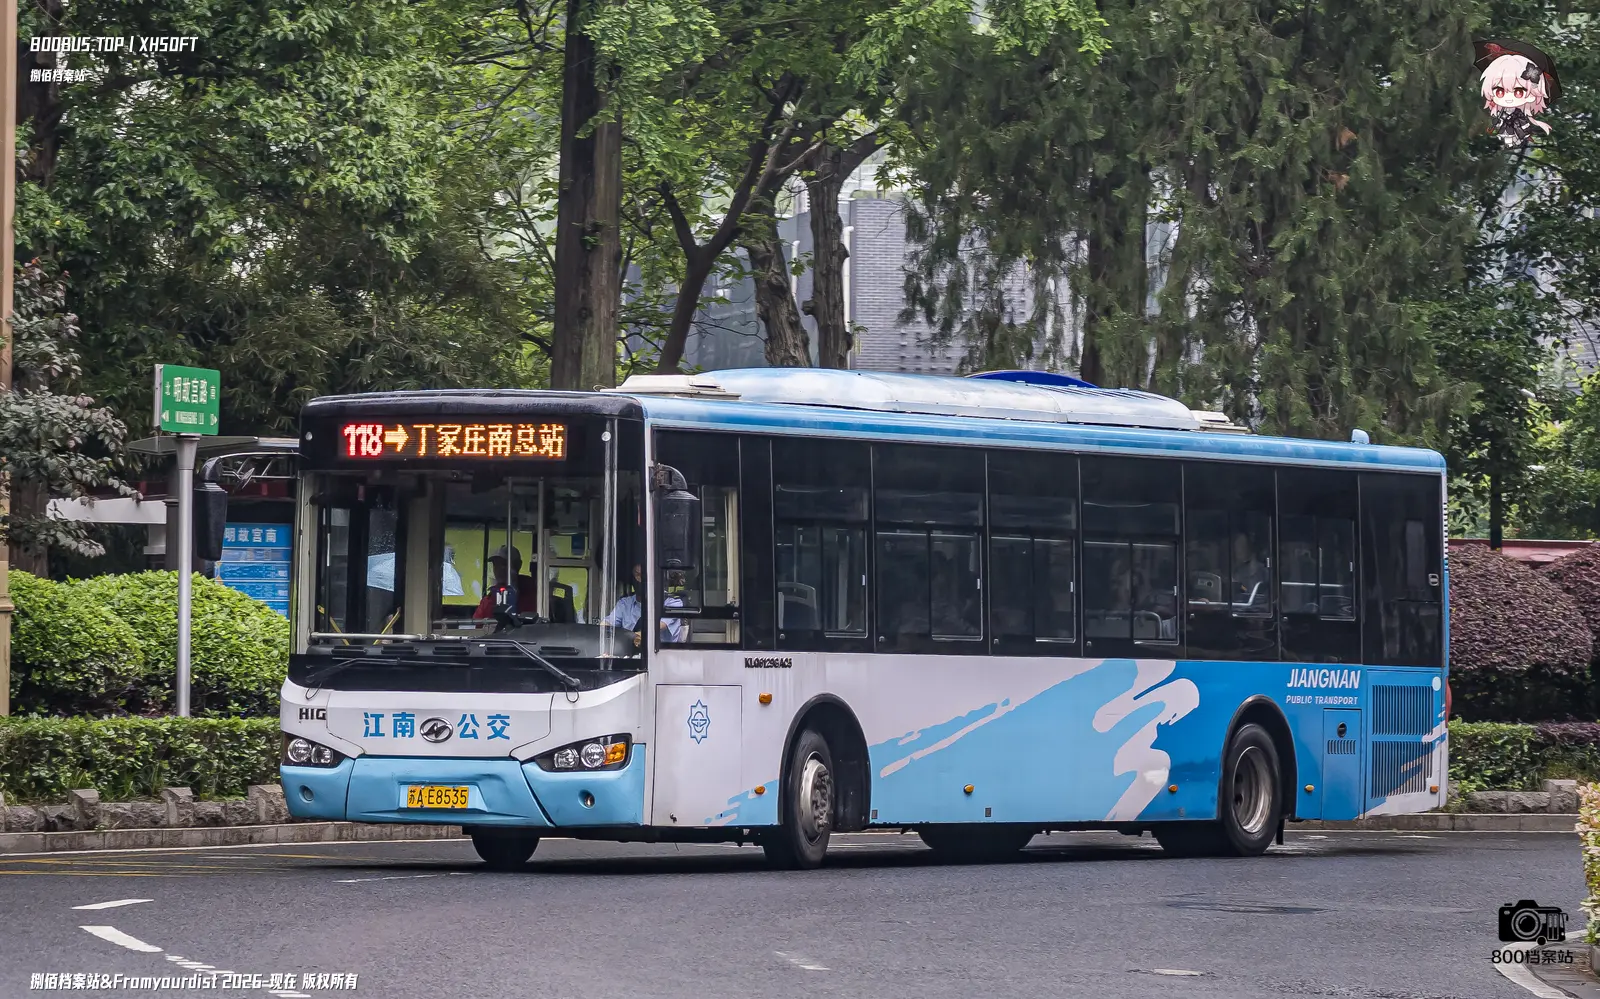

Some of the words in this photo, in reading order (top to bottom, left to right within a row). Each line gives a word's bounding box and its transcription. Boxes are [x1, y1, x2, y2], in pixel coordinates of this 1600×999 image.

[344, 424, 384, 456] 118
[412, 424, 565, 457] 丁家庄南总站
[224, 527, 278, 543] 明故宫南
[1286, 668, 1361, 689] JIANGNAN
[1286, 695, 1312, 704] PUBLIC
[1315, 696, 1358, 705] TRANSPORT
[298, 707, 327, 721] HIG
[363, 712, 416, 738] 江南
[457, 713, 511, 740] 公交
